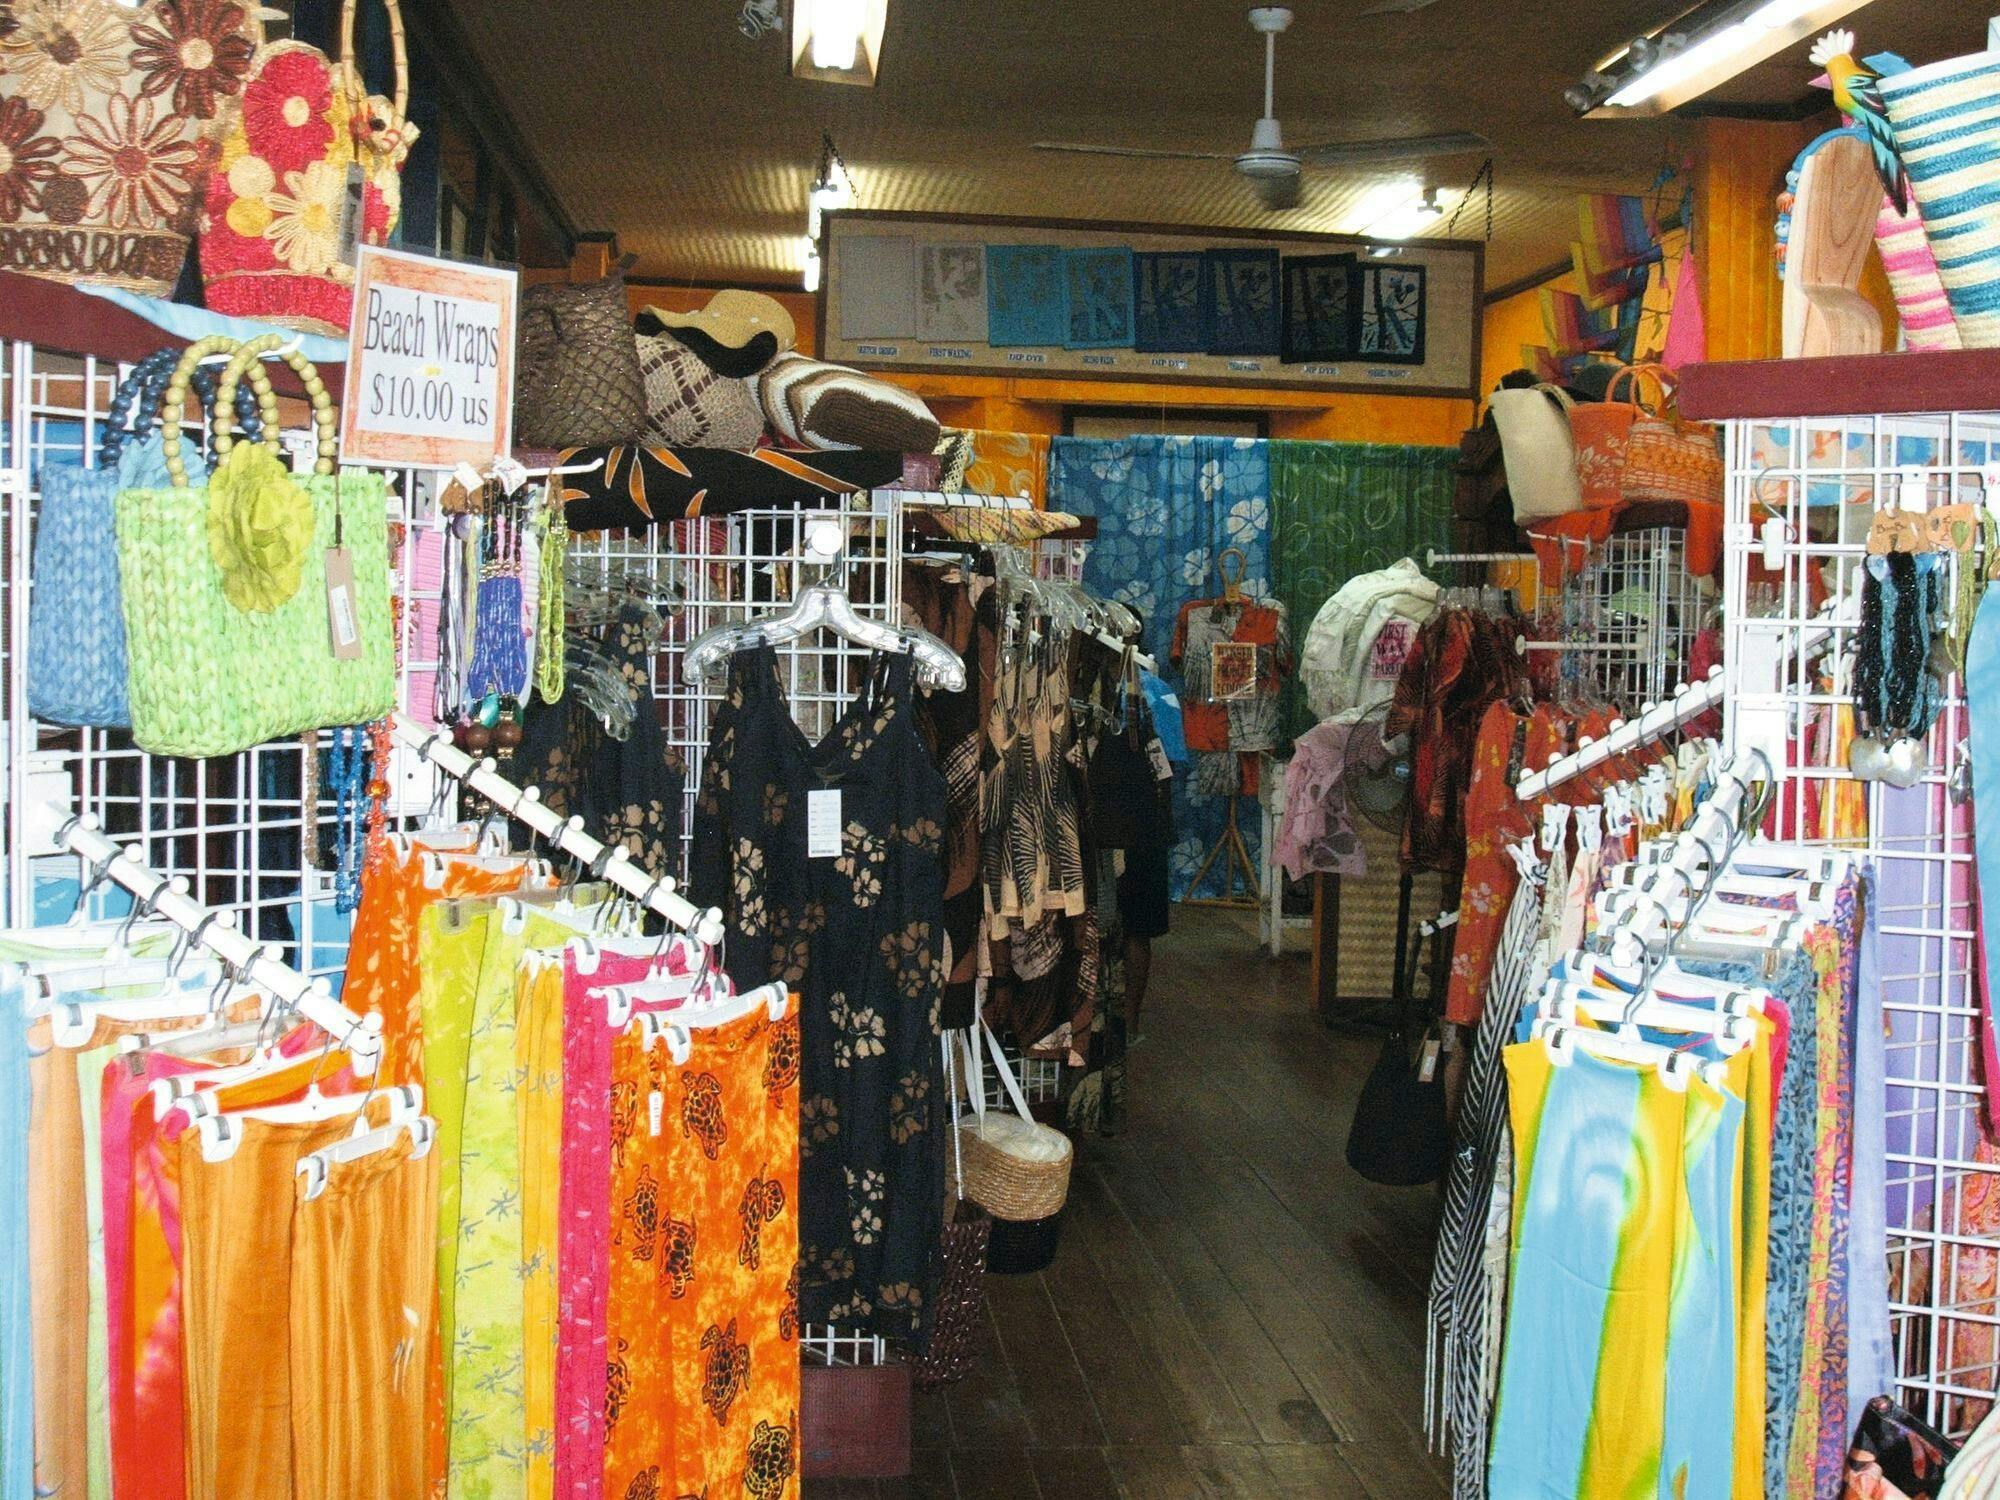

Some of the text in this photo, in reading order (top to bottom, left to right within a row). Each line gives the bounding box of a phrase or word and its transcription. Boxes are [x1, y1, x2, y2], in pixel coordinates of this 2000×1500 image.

[363, 288, 499, 384] Beach Wraps
[370, 373, 488, 426] $10.00 us
[1376, 643, 1406, 658] WAX
